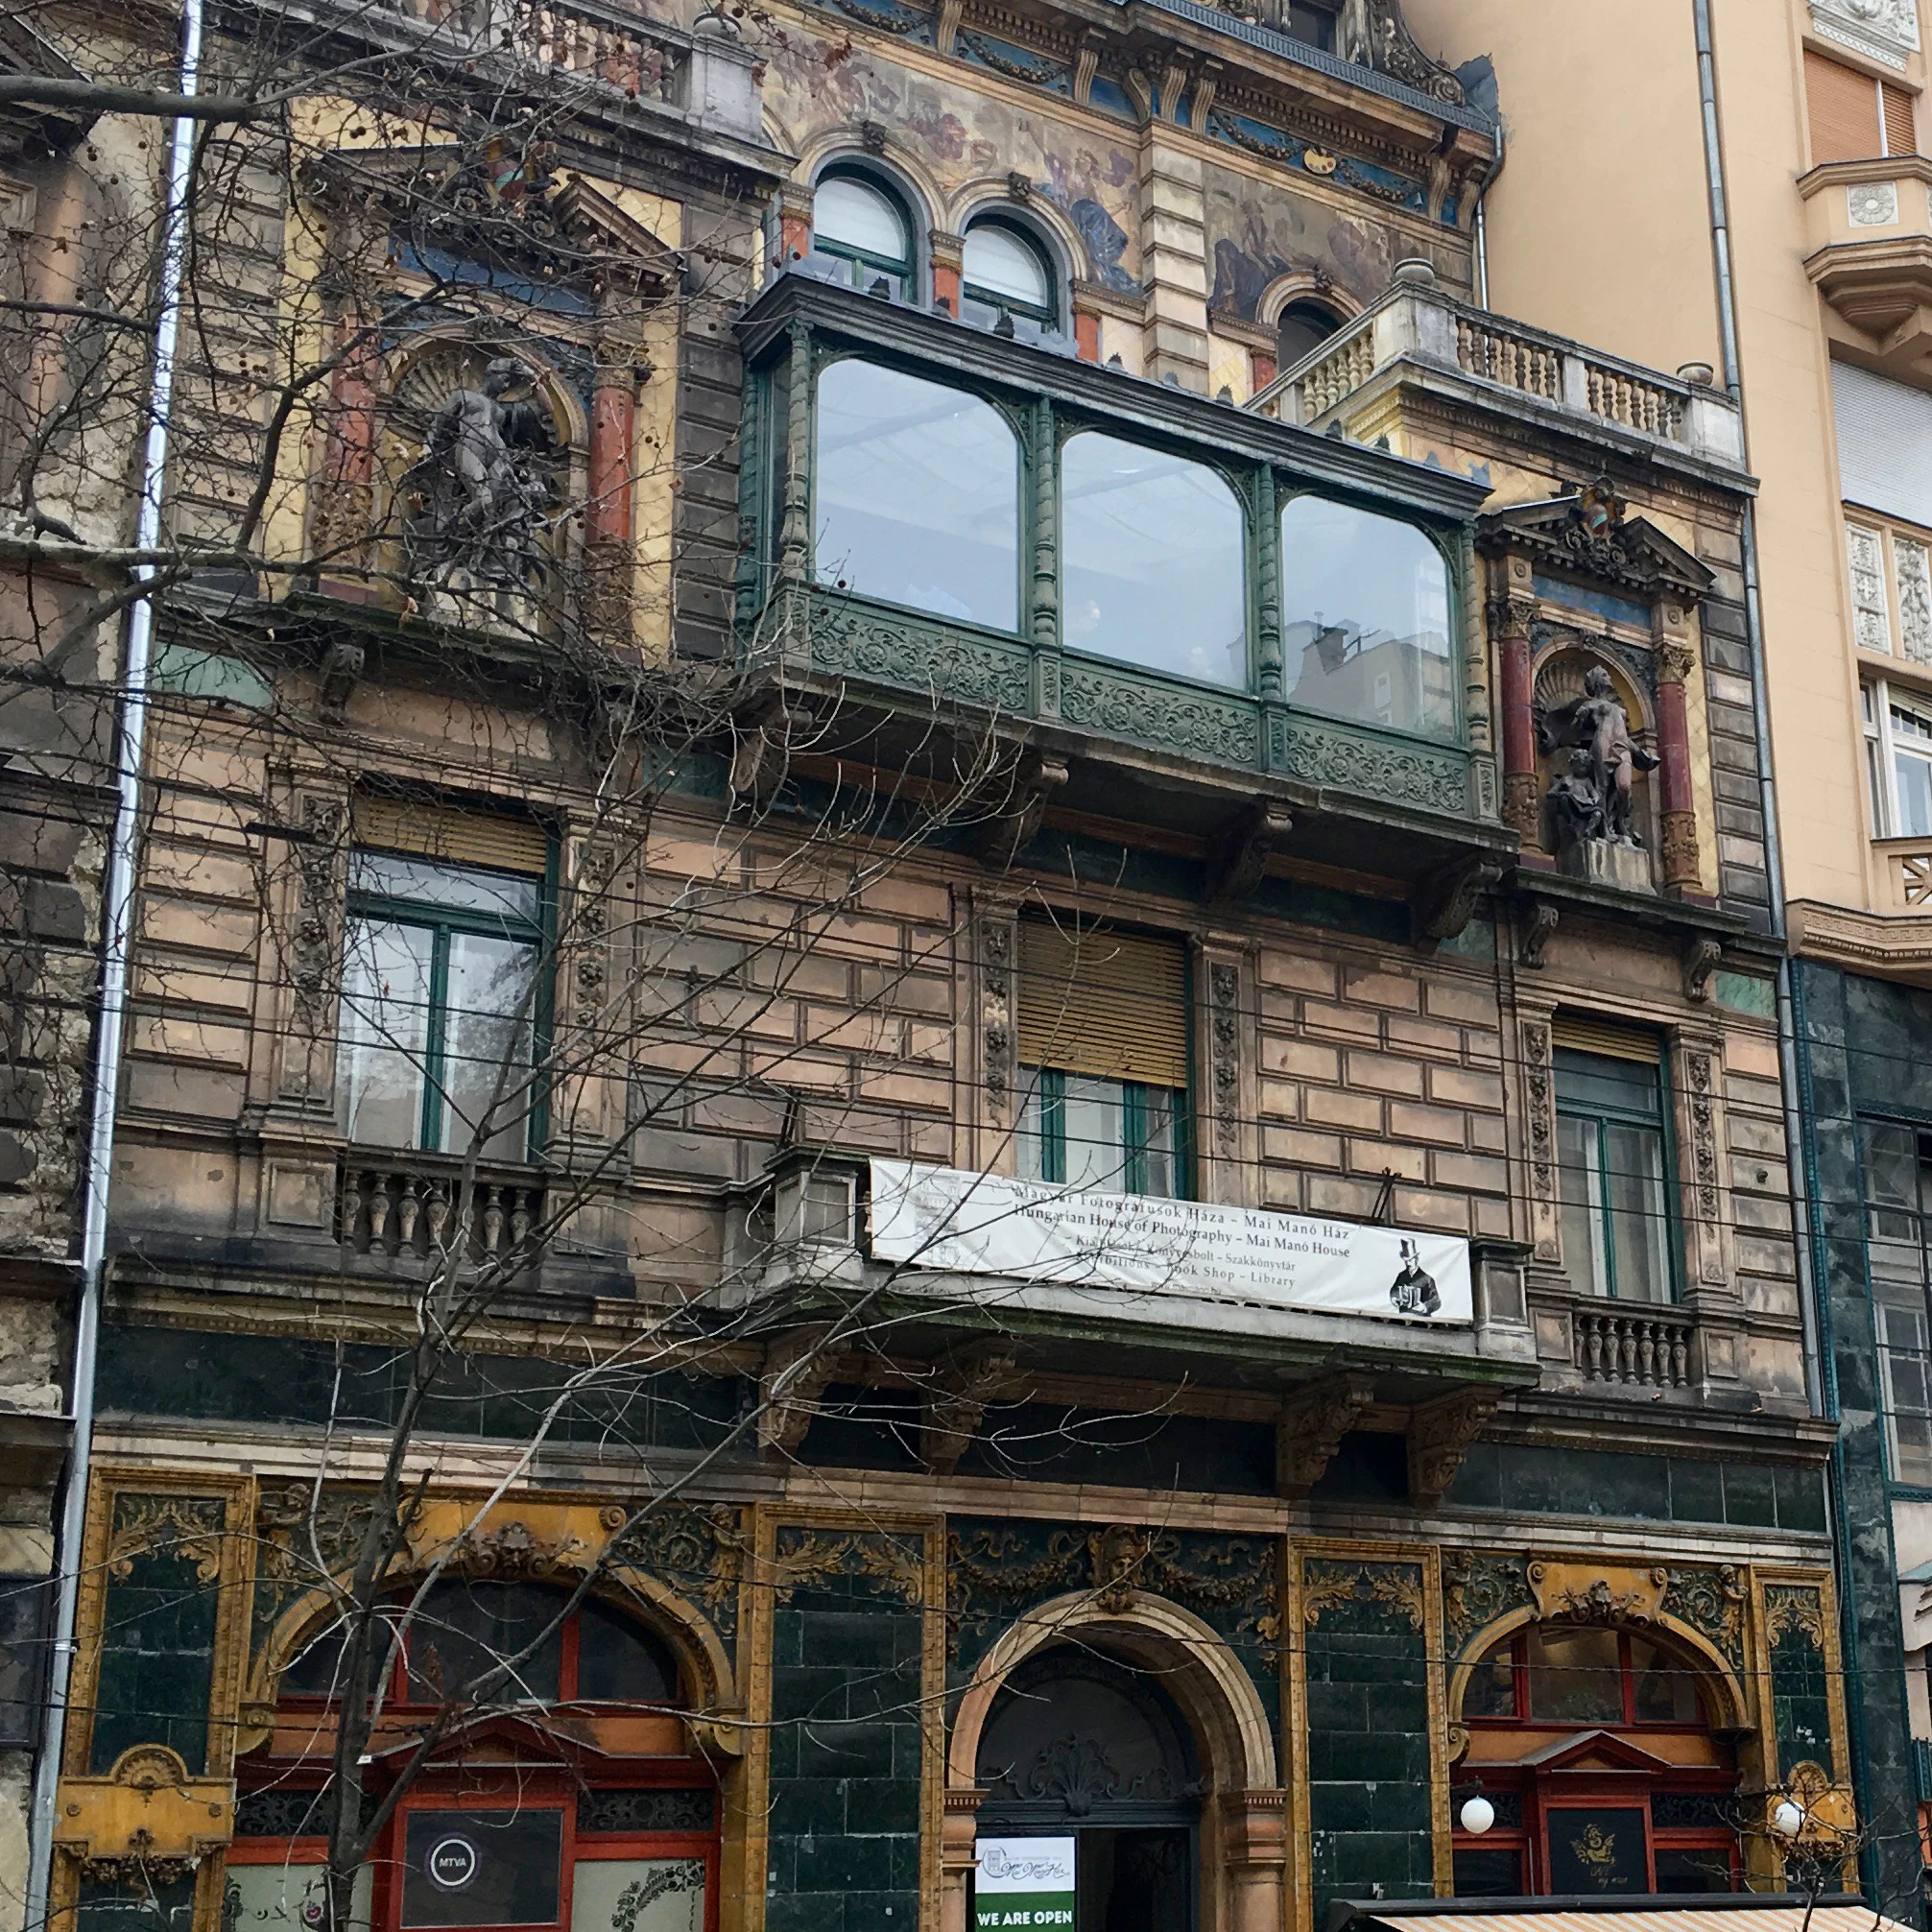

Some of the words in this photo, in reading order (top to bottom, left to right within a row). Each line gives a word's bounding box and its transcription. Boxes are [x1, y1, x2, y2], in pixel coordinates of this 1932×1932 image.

[1014, 1204, 1085, 1225] Hungarian
[1090, 1213, 1132, 1229] House
[1134, 1220, 1148, 1232] of
[1152, 1221, 1232, 1246] Photography
[1246, 1233, 1271, 1248] Mai
[1274, 1237, 1309, 1252] Manó
[1312, 1242, 1350, 1258] House
[1189, 1207, 1225, 1224] Háza
[1244, 1215, 1271, 1229] Mai
[1277, 1219, 1317, 1235] Manó
[1323, 1225, 1349, 1240] Ház
[1204, 1266, 1235, 1282] Shop
[1251, 1272, 1296, 1289] Library
[977, 1912, 999, 1926] WE
[1002, 1911, 1031, 1926] ARE
[1034, 1910, 1072, 1925] OPEN
